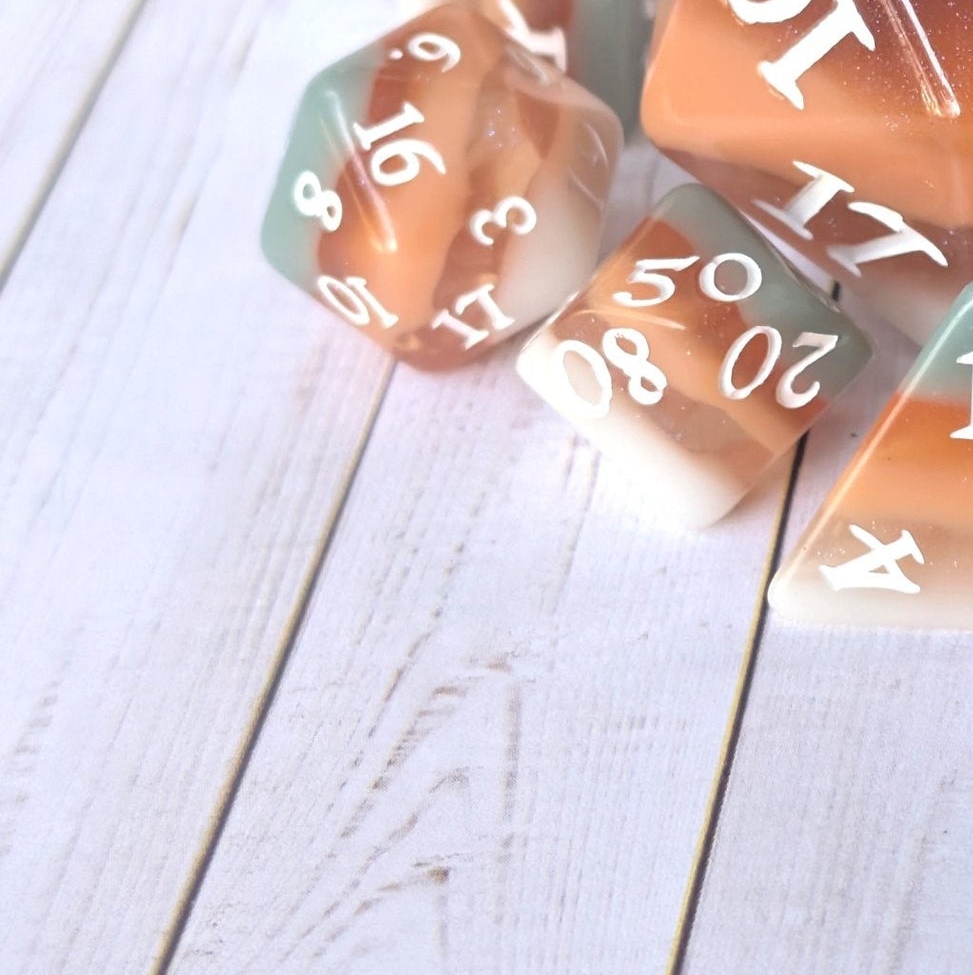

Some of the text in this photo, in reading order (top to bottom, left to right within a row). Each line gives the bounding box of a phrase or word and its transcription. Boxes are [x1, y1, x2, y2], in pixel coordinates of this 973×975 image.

[353, 101, 446, 187] 16
[293, 170, 343, 232] 8
[469, 196, 537, 247] 3
[749, 160, 949, 278] 17
[612, 252, 762, 307] 50
[718, 325, 839, 409] 20
[818, 524, 925, 594] 4
